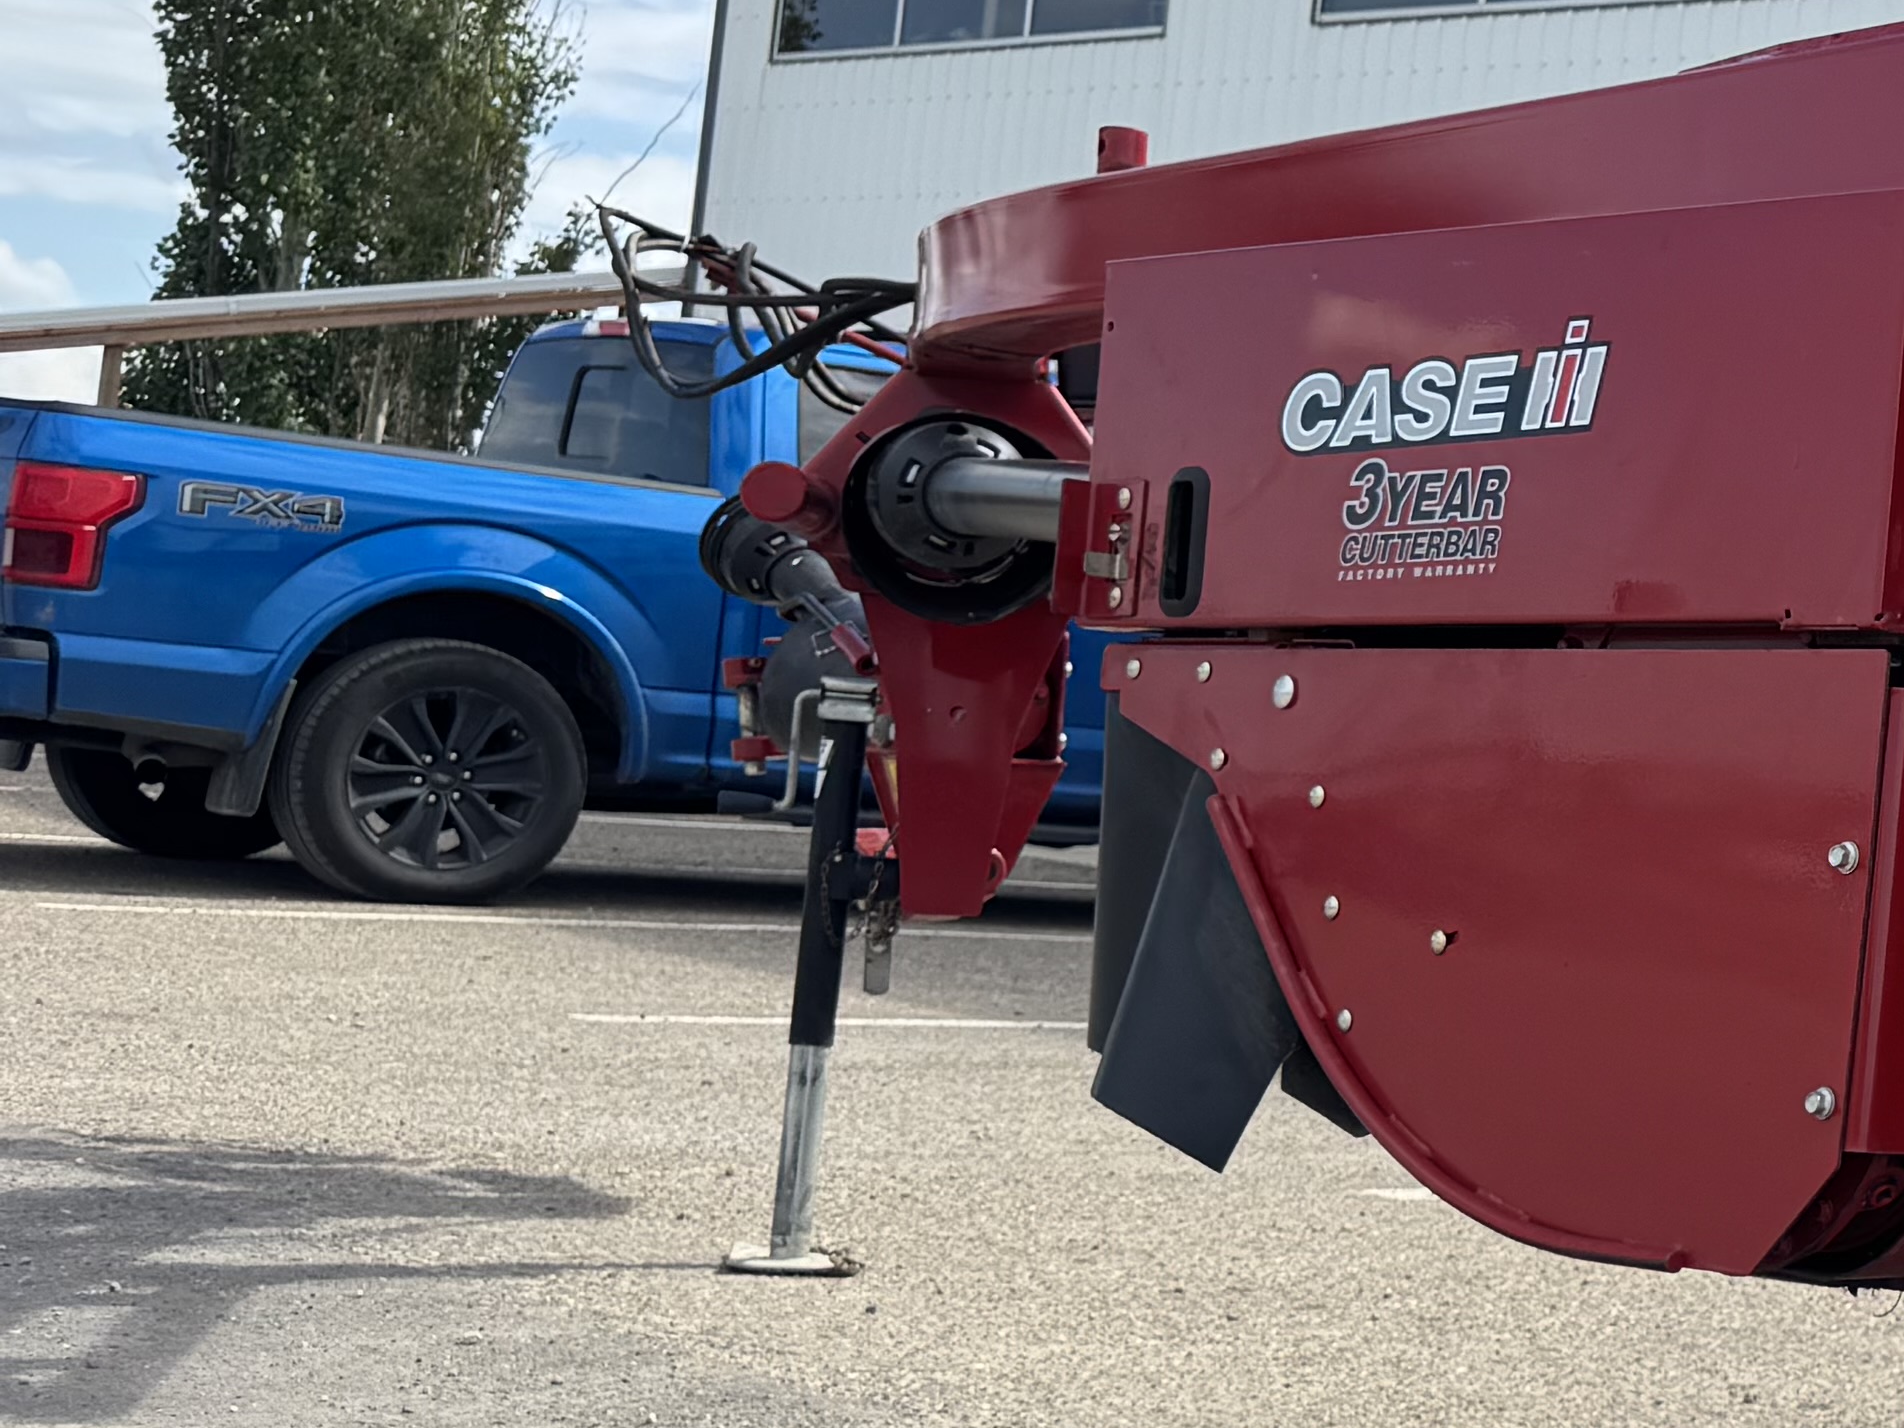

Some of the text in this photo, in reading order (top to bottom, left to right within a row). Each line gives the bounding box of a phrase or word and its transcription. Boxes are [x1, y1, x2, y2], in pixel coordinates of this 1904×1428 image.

[1283, 354, 1519, 453] CASE
[176, 478, 344, 527] FX4
[1339, 525, 1502, 567] CUTTERBAR
[1337, 563, 1497, 582] FACTORY WARRANTY
